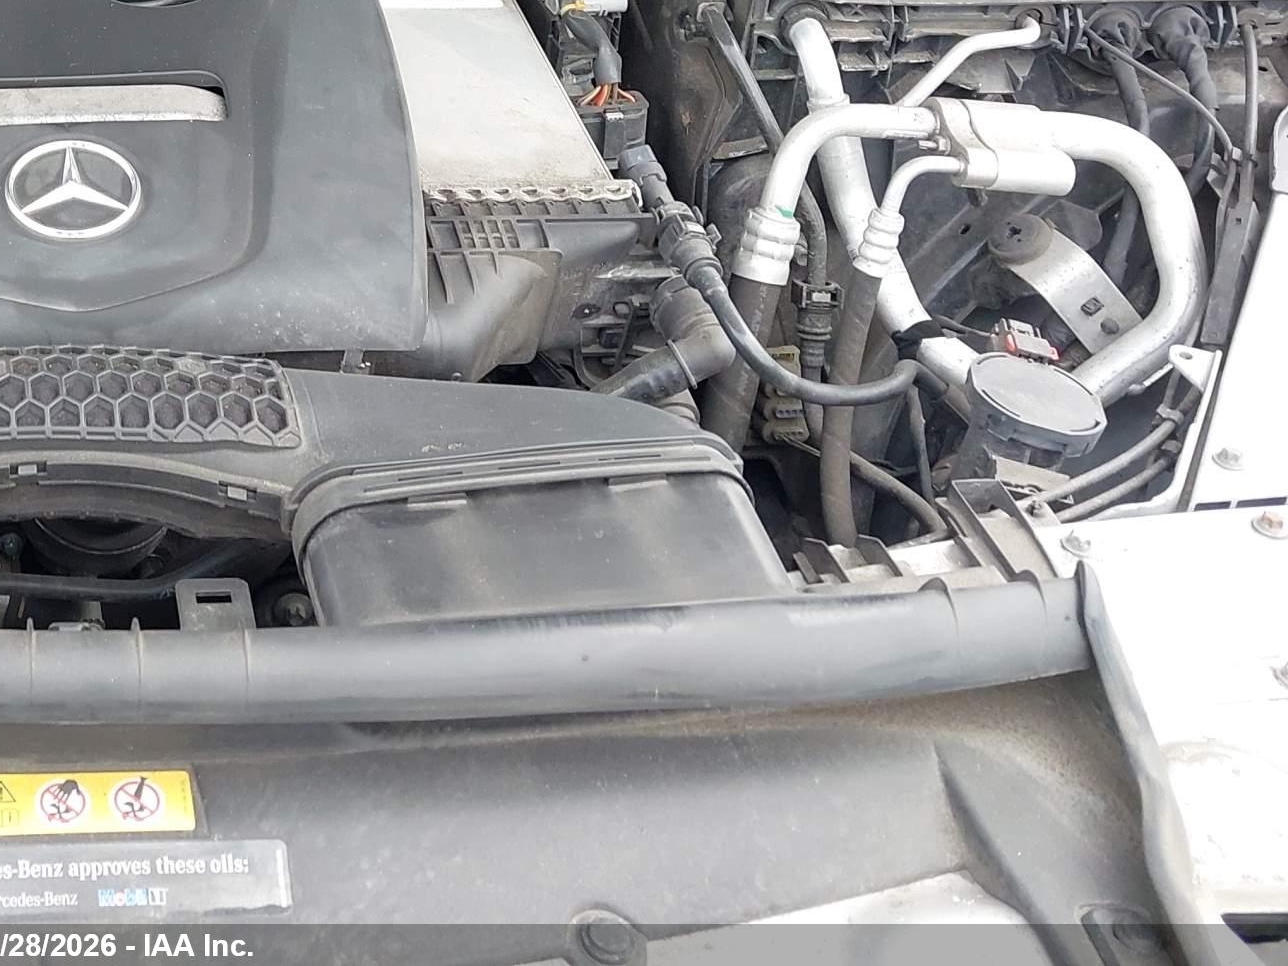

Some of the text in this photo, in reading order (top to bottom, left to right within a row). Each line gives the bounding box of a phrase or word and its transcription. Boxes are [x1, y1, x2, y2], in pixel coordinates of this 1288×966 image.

[68, 860, 151, 881] approves
[156, 855, 206, 875] these
[210, 853, 249, 874] oils:
